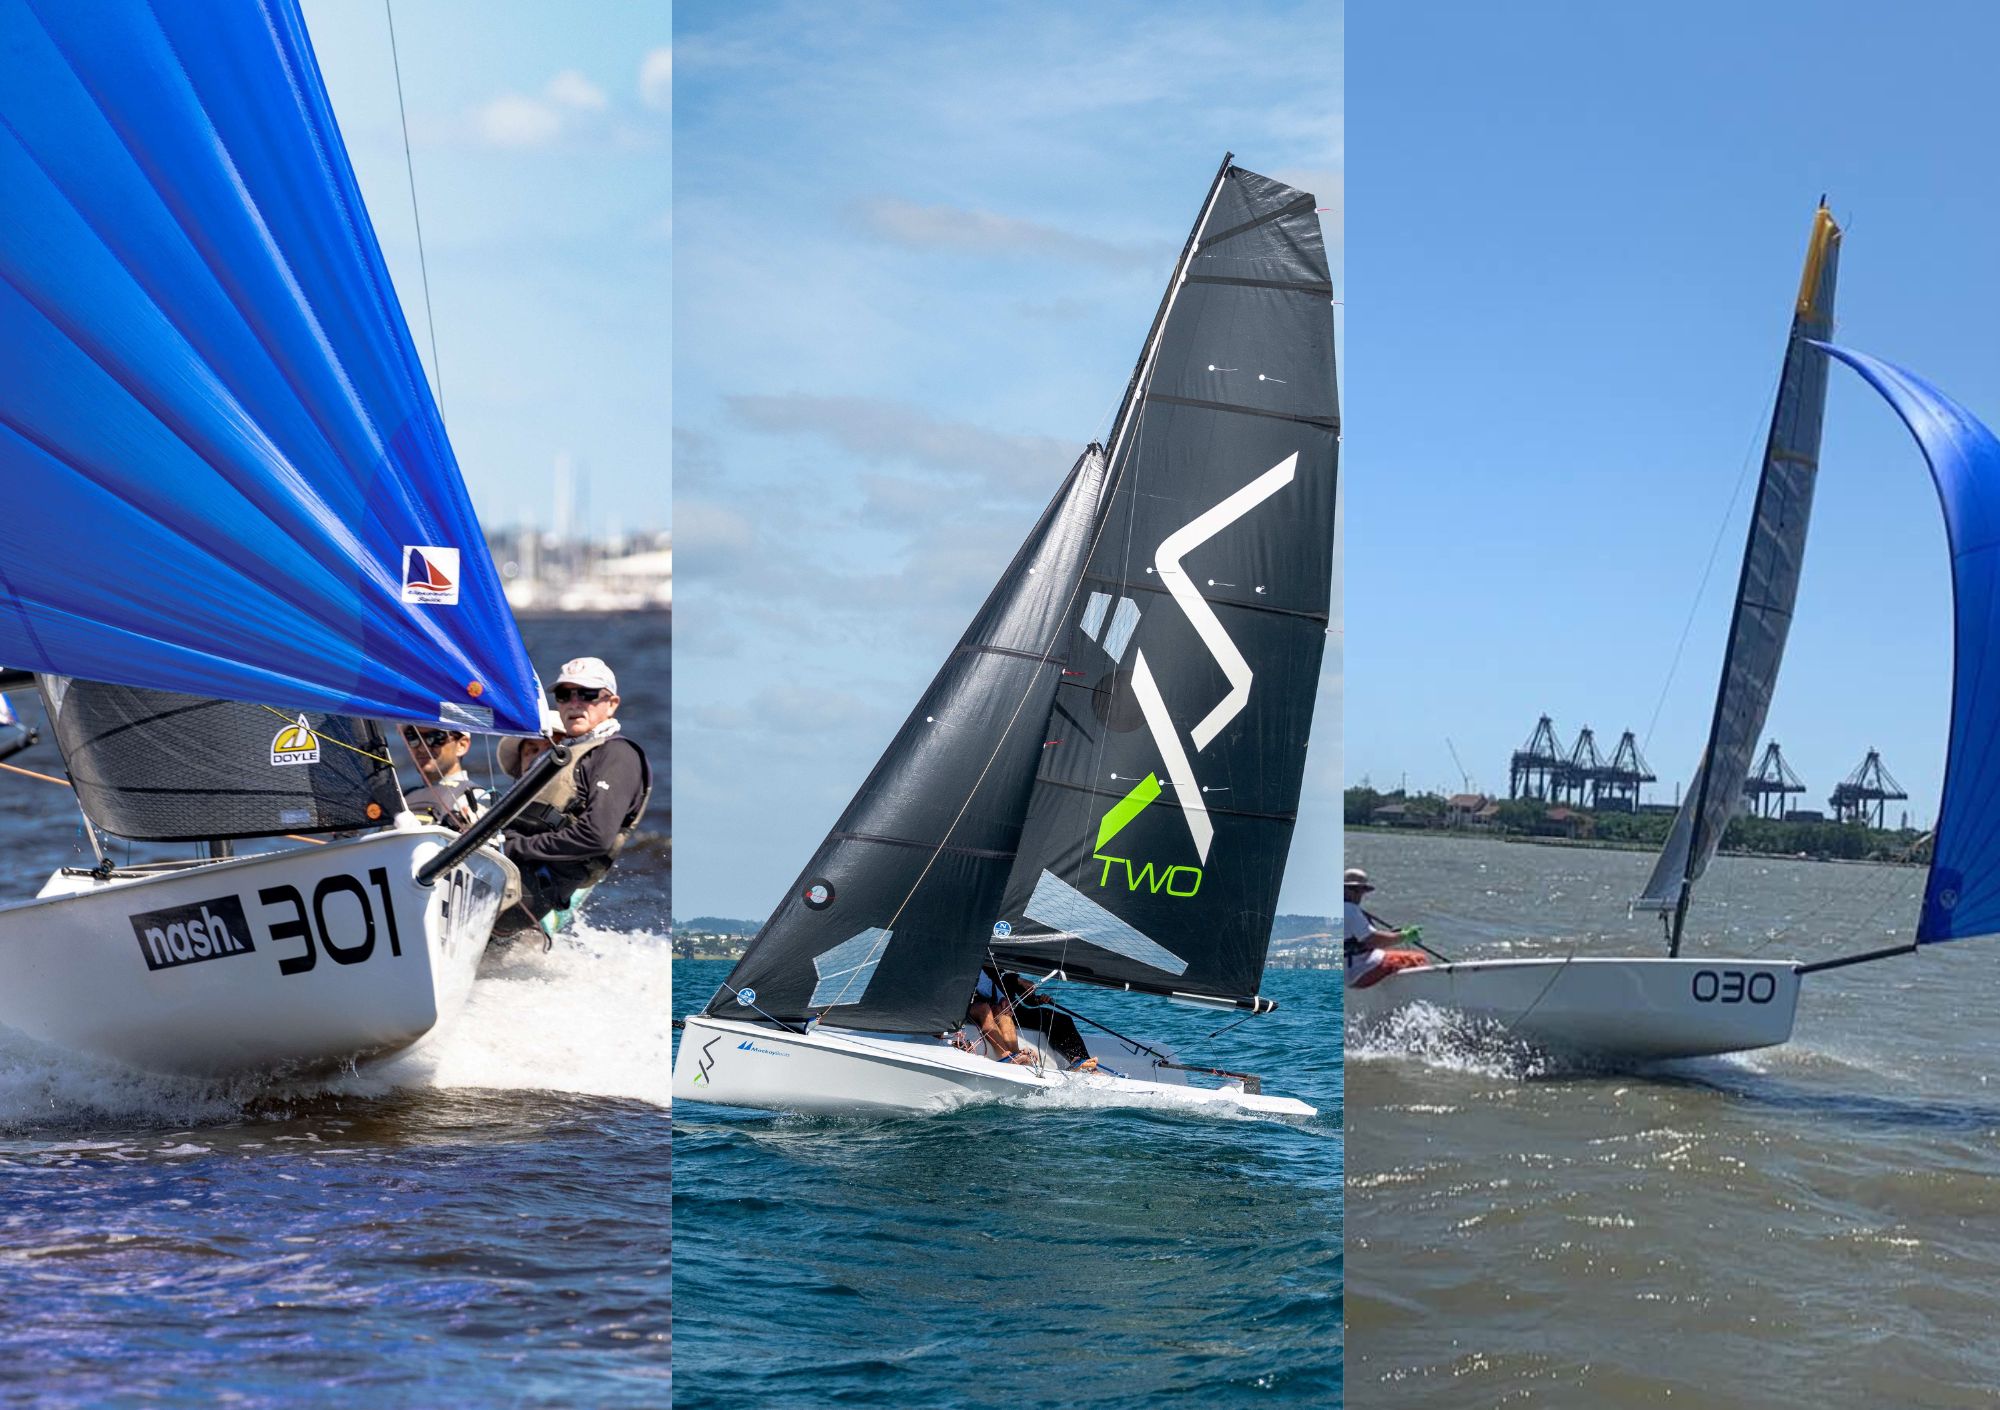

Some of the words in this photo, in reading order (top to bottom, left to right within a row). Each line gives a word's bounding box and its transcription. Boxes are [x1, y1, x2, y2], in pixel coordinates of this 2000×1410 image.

[273, 752, 318, 763] DOYLE
[1093, 853, 1202, 897] TWO
[258, 867, 401, 976] 301
[1692, 970, 1776, 1004] 030
